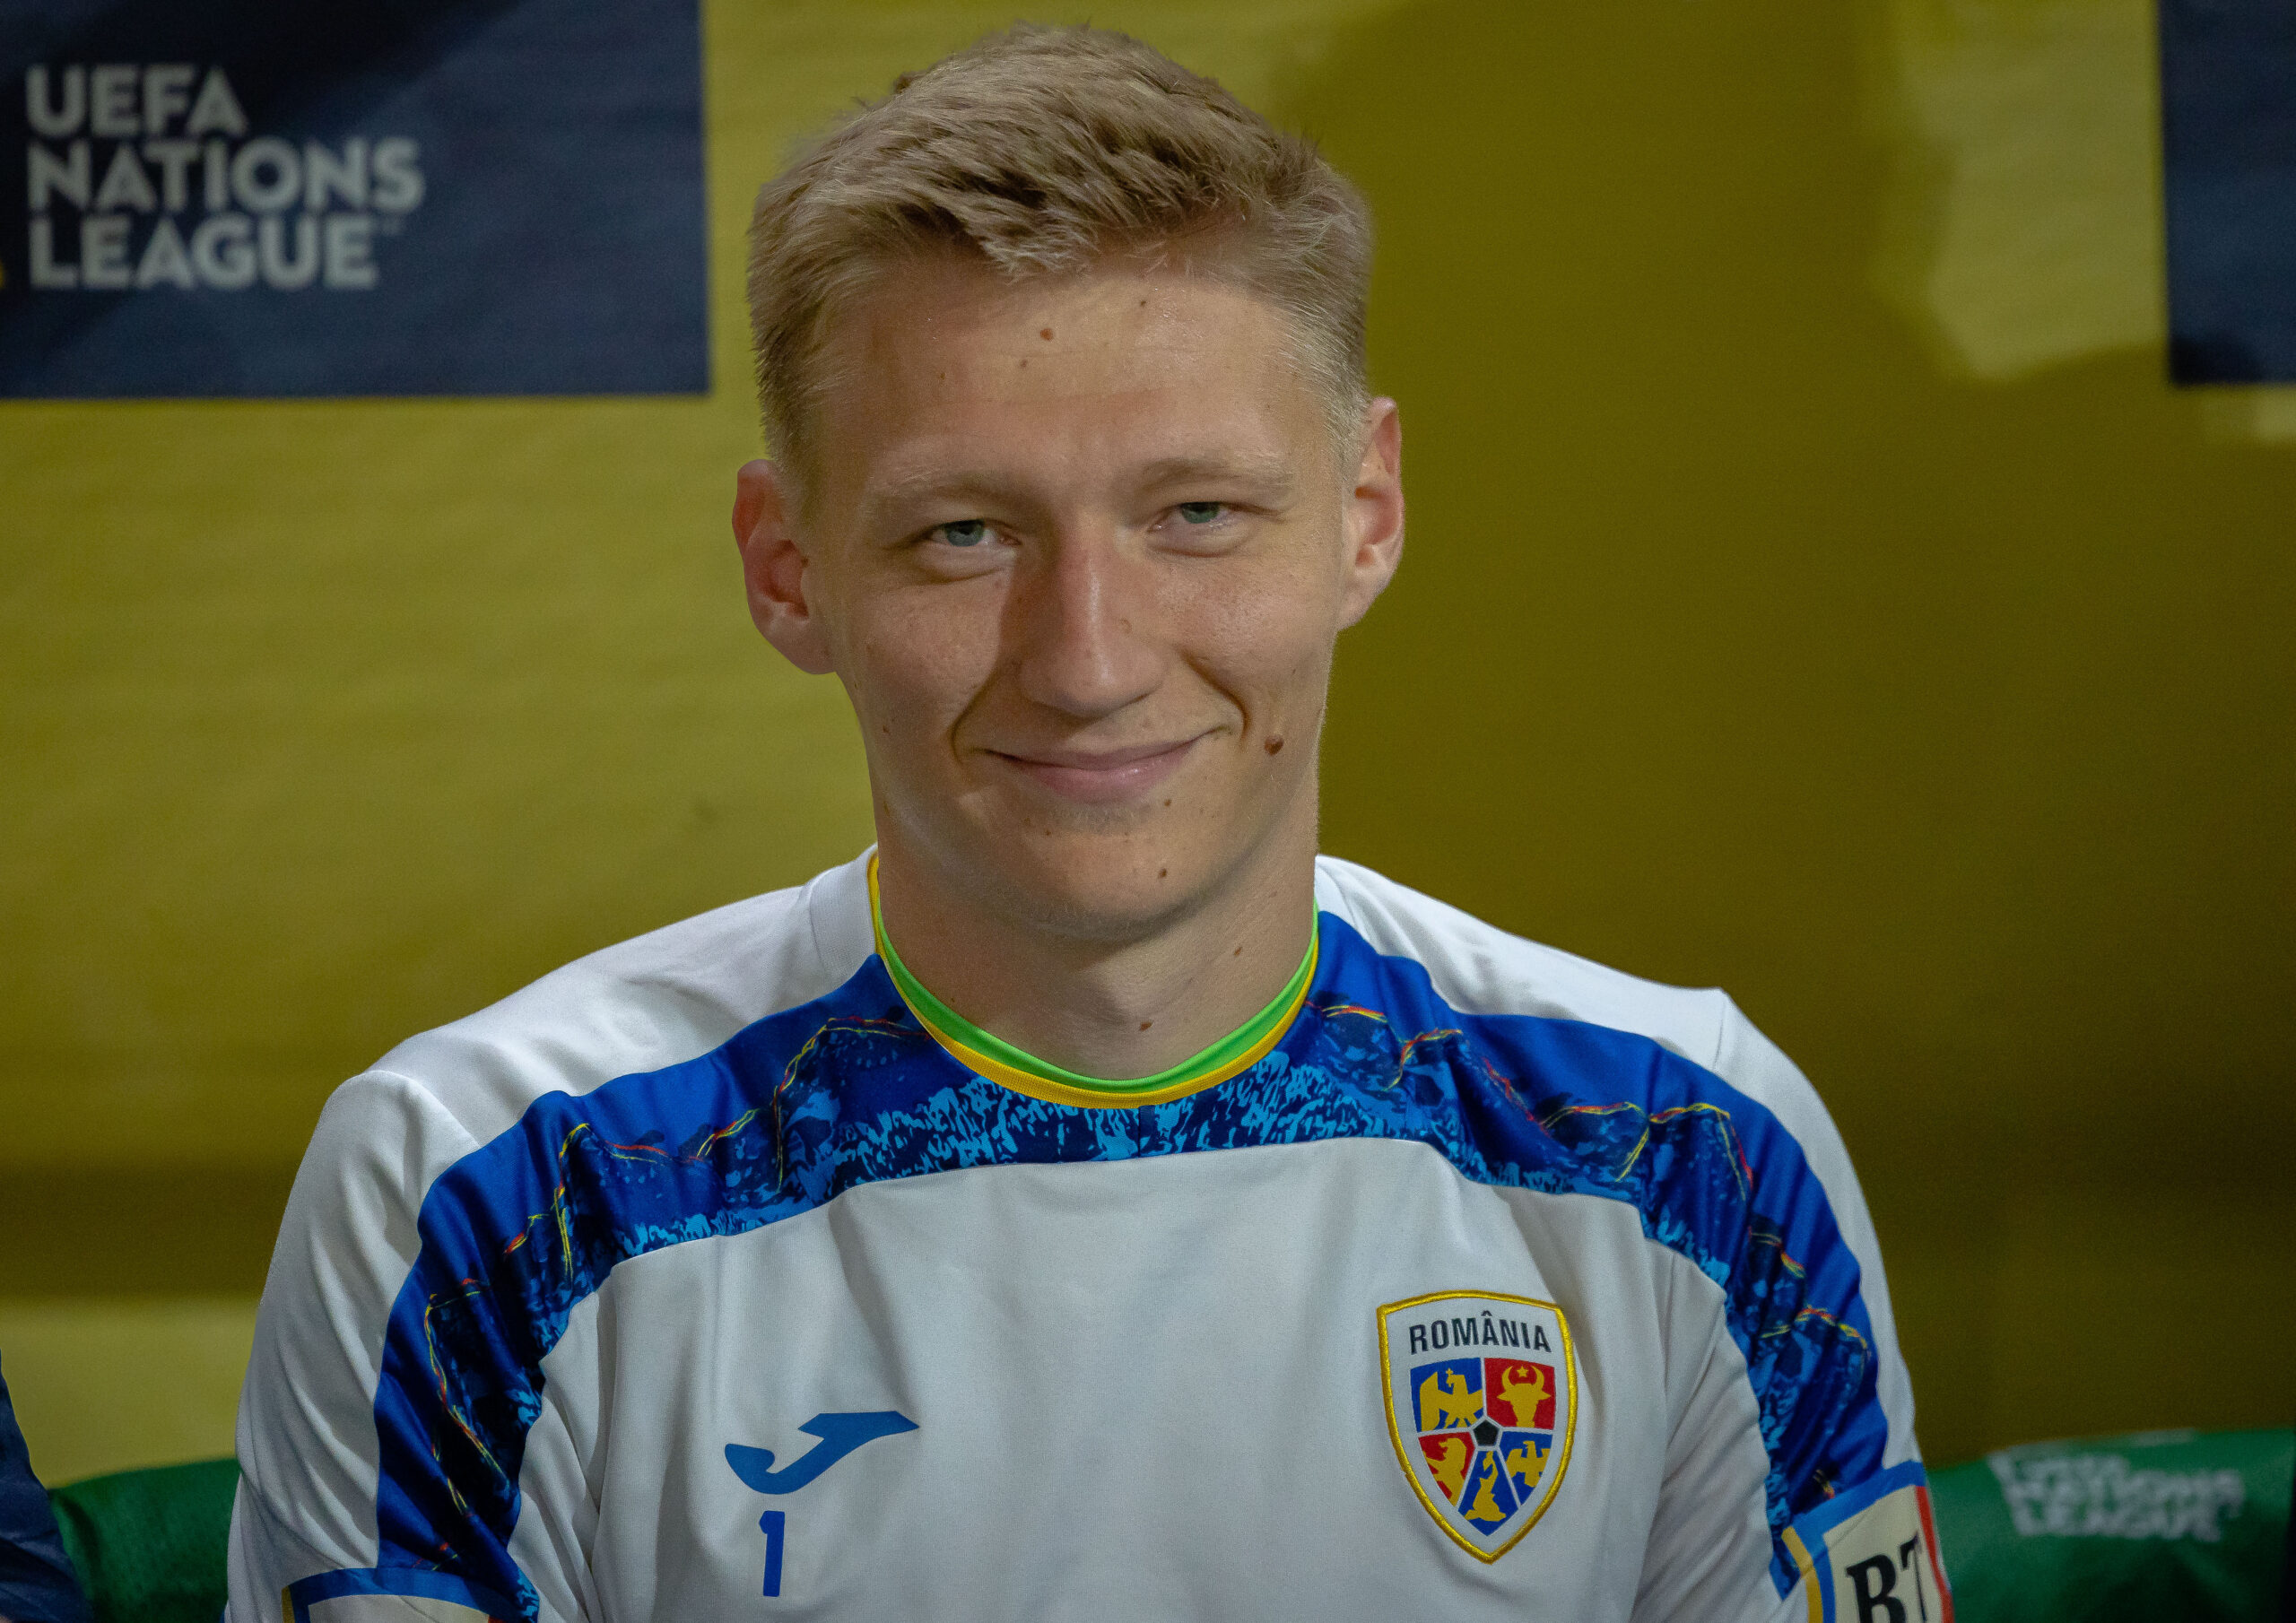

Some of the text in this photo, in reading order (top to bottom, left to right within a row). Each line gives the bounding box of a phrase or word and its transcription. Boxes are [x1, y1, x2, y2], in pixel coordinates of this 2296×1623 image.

[27, 65, 247, 135] UEFA
[28, 136, 425, 213] NATIONS
[30, 215, 378, 290] LEAGUE
[1408, 1310, 1552, 1355] ROMÂNIA
[759, 1510, 786, 1598] 1
